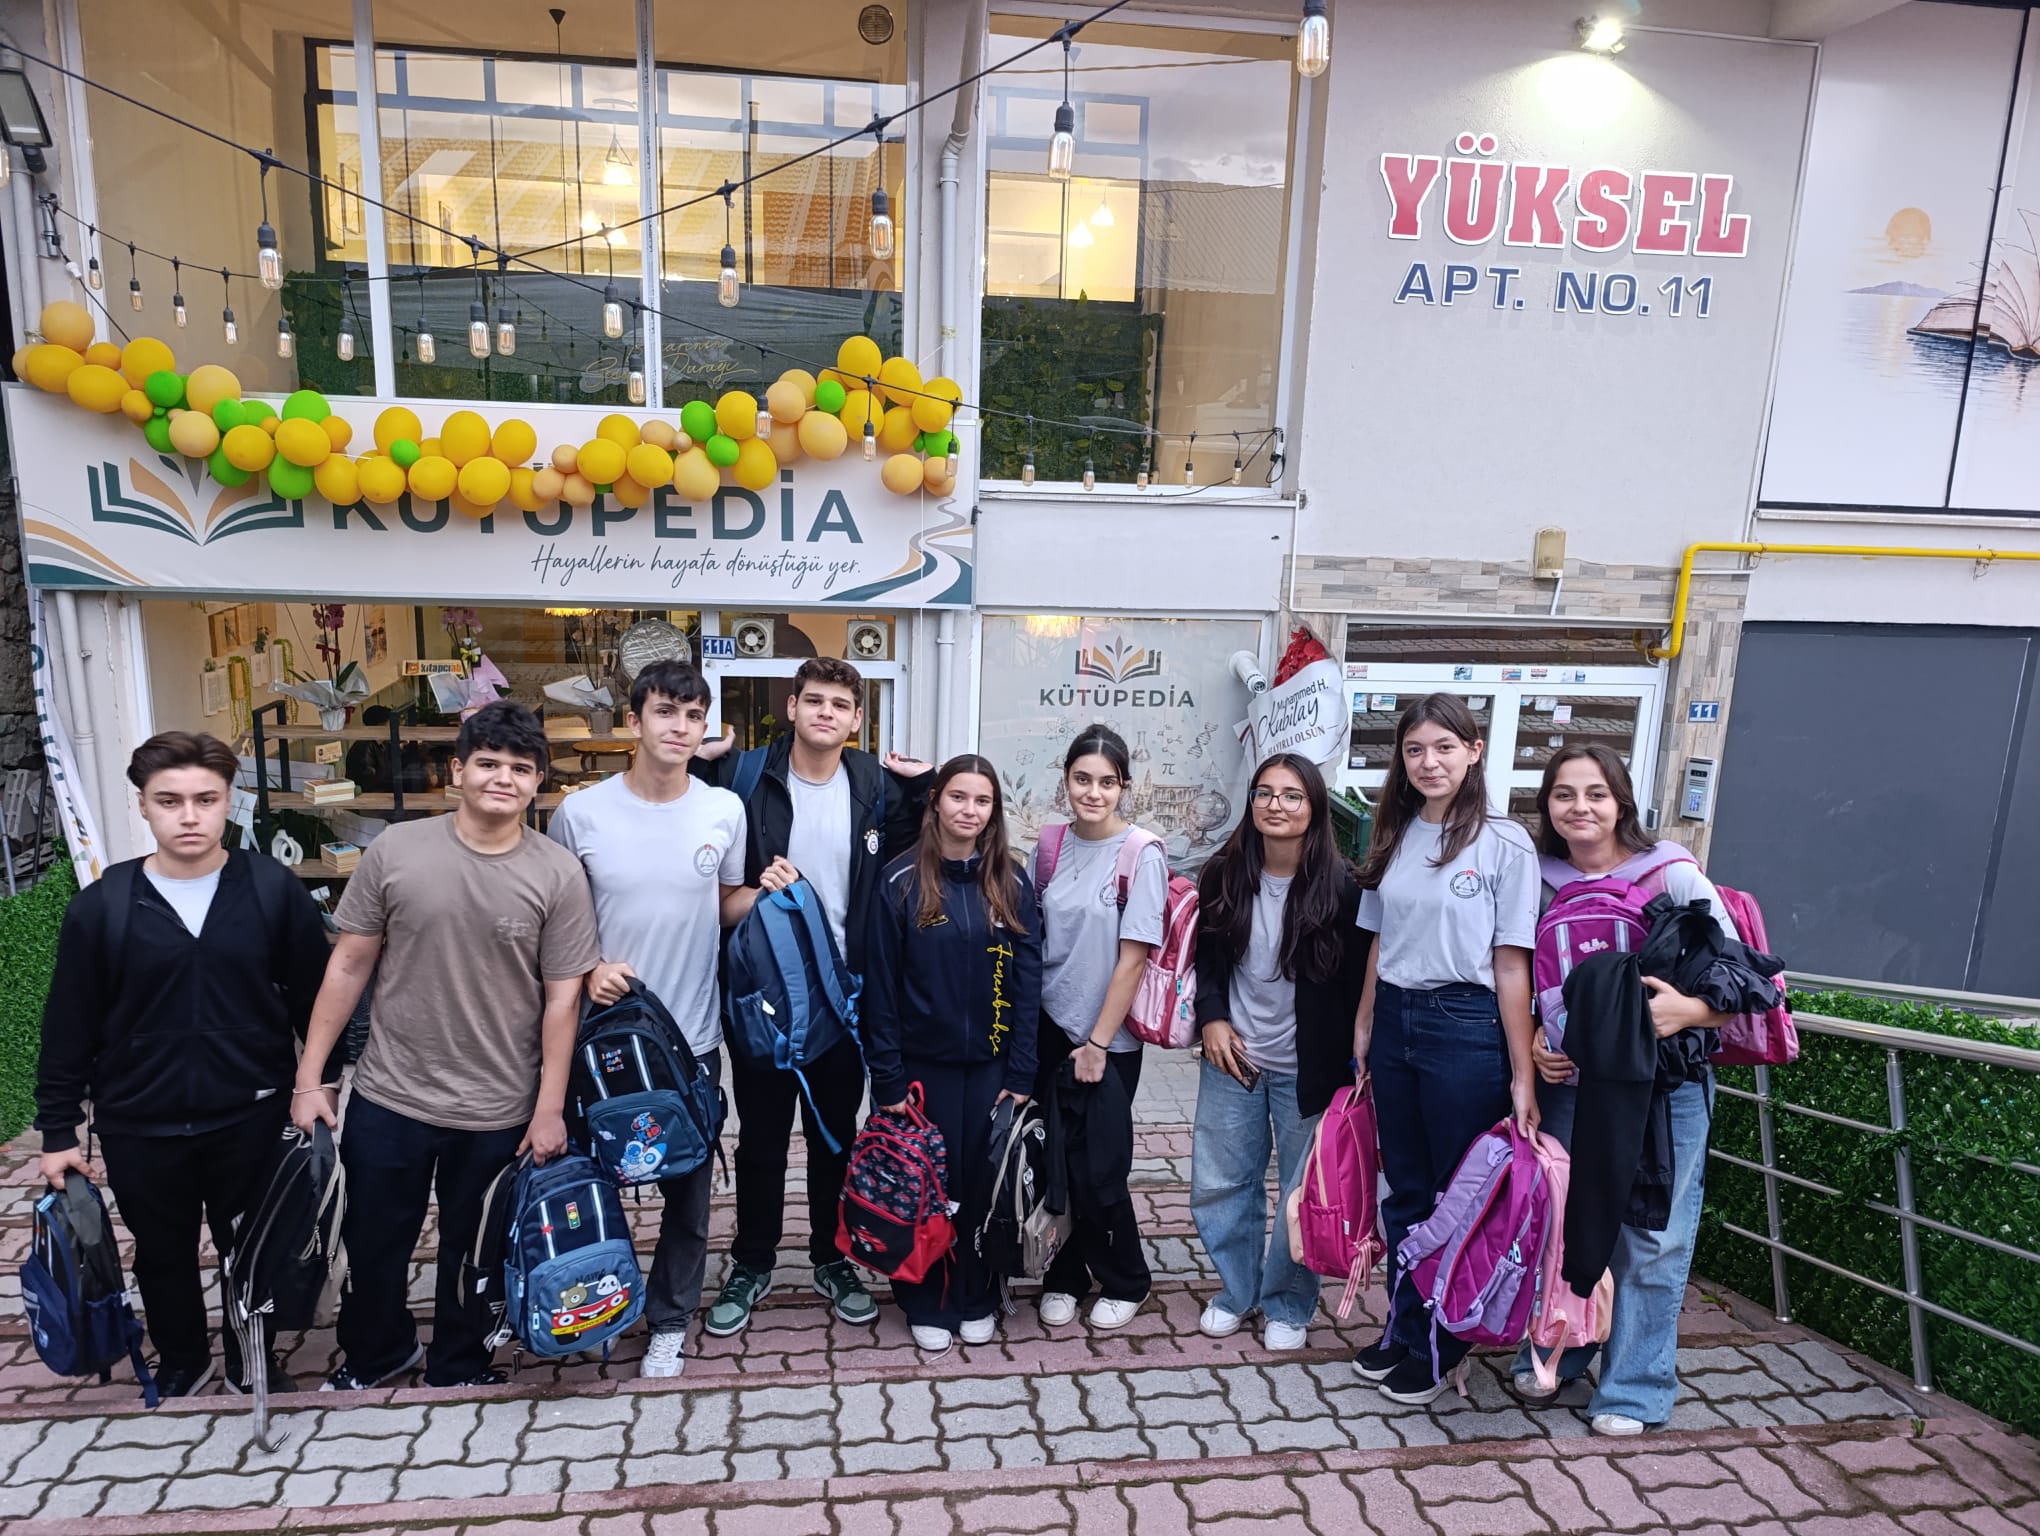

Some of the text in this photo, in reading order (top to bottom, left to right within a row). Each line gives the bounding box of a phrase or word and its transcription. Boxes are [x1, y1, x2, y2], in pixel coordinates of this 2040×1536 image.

[1379, 131, 1751, 258] YÜKSEL
[1394, 261, 1525, 310] APT.
[531, 542, 862, 590] Hayallerin hayata dönüştüğü yer.
[1039, 684, 1195, 708] KÜTÜPEDİA
[1694, 704, 1713, 718] 11
[1258, 697, 1319, 748] Kubilay
[1294, 725, 1326, 744] OLSUN
